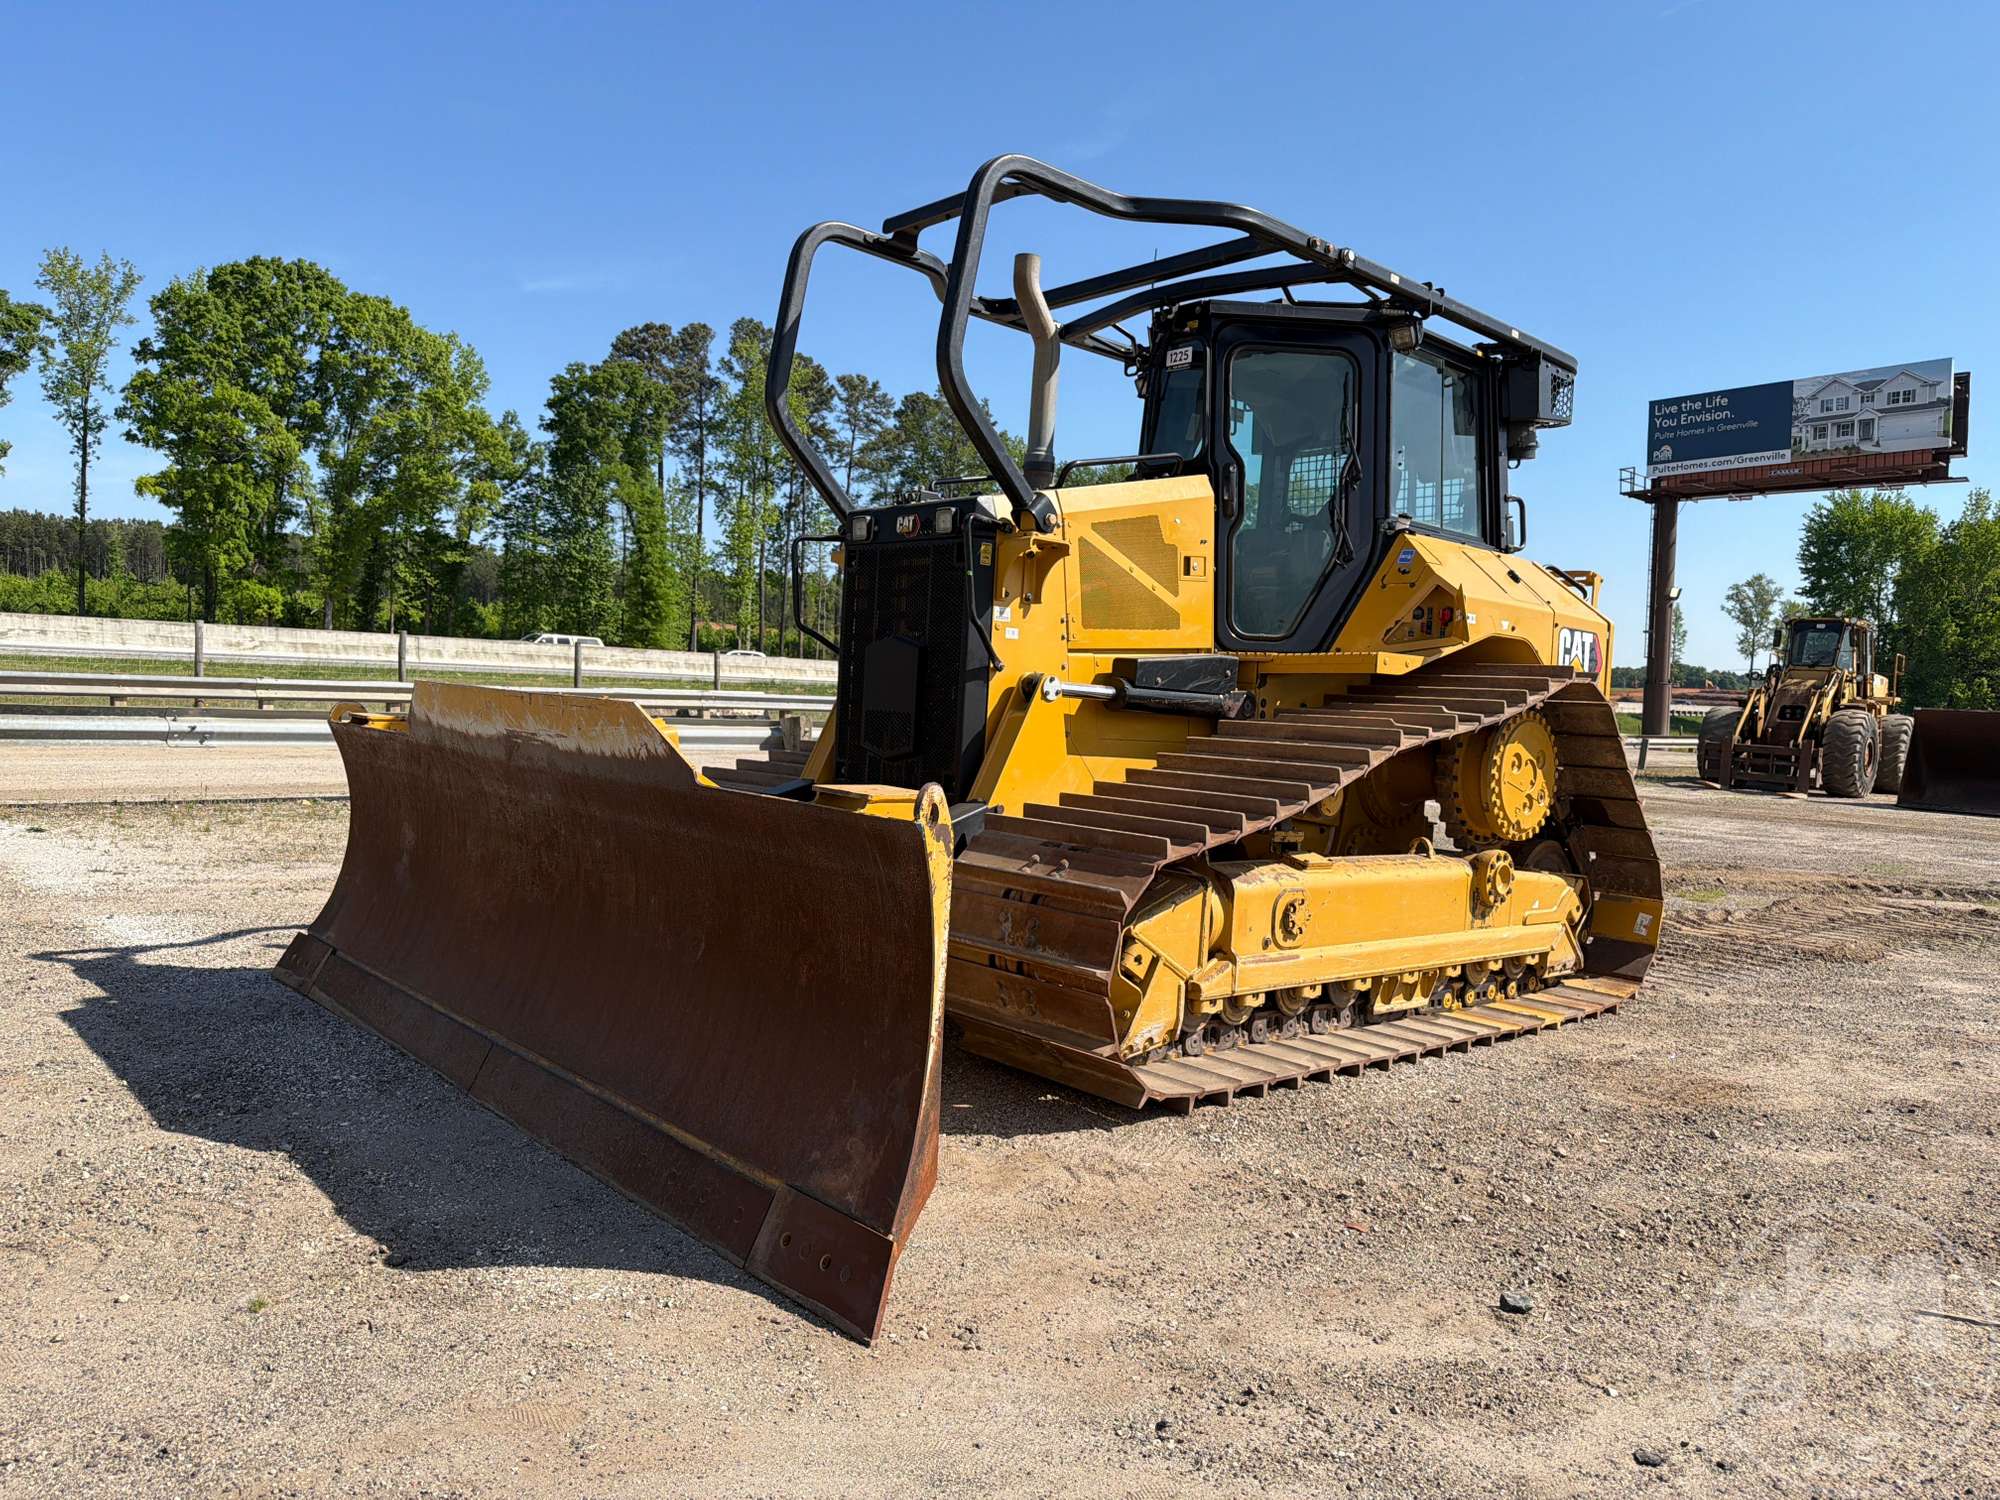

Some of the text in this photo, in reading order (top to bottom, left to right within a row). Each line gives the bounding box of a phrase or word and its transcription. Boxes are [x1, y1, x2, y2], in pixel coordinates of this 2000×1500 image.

[1170, 350, 1189, 363] 1225
[1655, 395, 1728, 415] Live the Life
[1654, 410, 1735, 428] You Envision.
[1655, 431, 1674, 440] Pulte
[1676, 428, 1704, 437] Homes
[1716, 420, 1759, 431] Greenville
[1652, 452, 1786, 474] PulteHomes.com/Greenville
[896, 515, 914, 532] CAT
[1558, 628, 1594, 672] CAT
